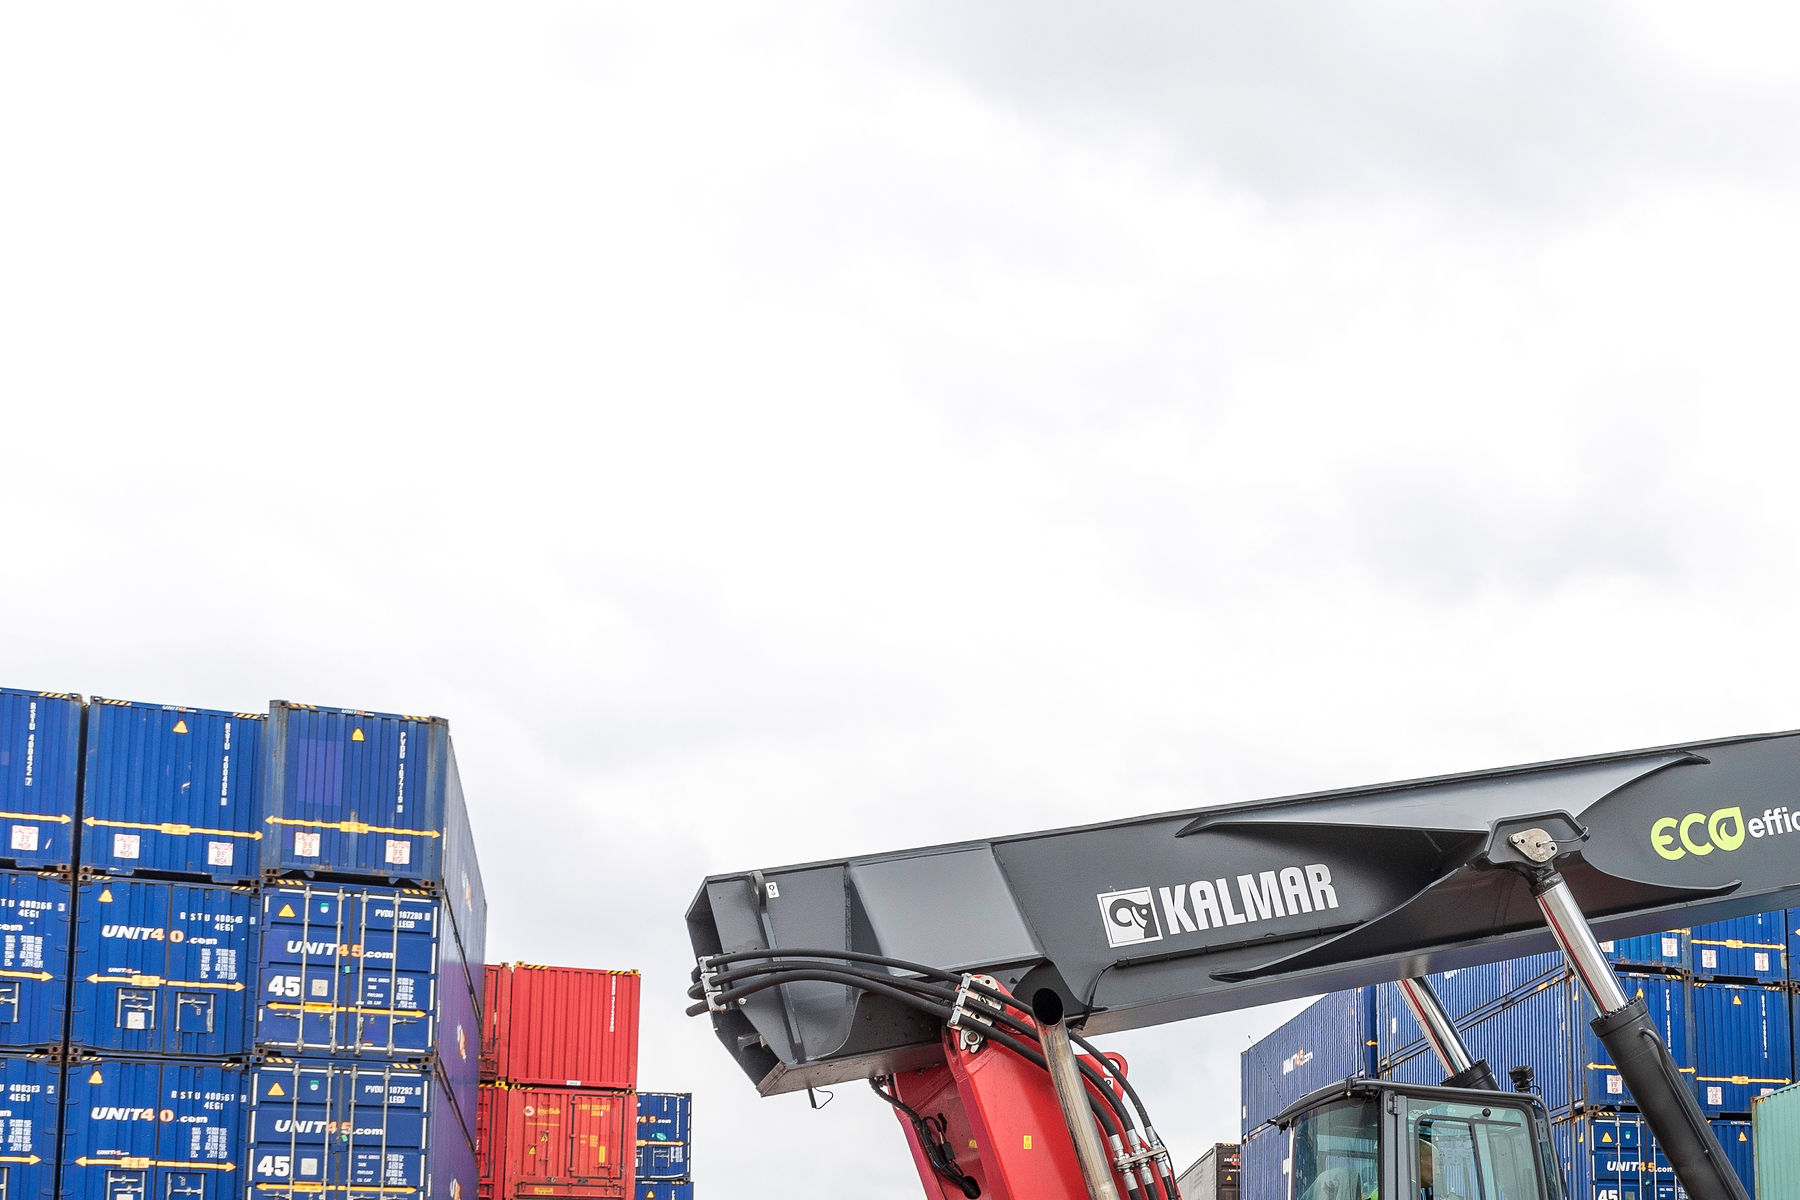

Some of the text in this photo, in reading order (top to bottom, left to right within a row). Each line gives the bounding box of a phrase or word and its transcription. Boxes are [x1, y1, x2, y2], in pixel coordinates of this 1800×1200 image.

[1159, 863, 1339, 935] KALMAR
[268, 975, 300, 997] 45
[257, 1155, 291, 1177] 45
